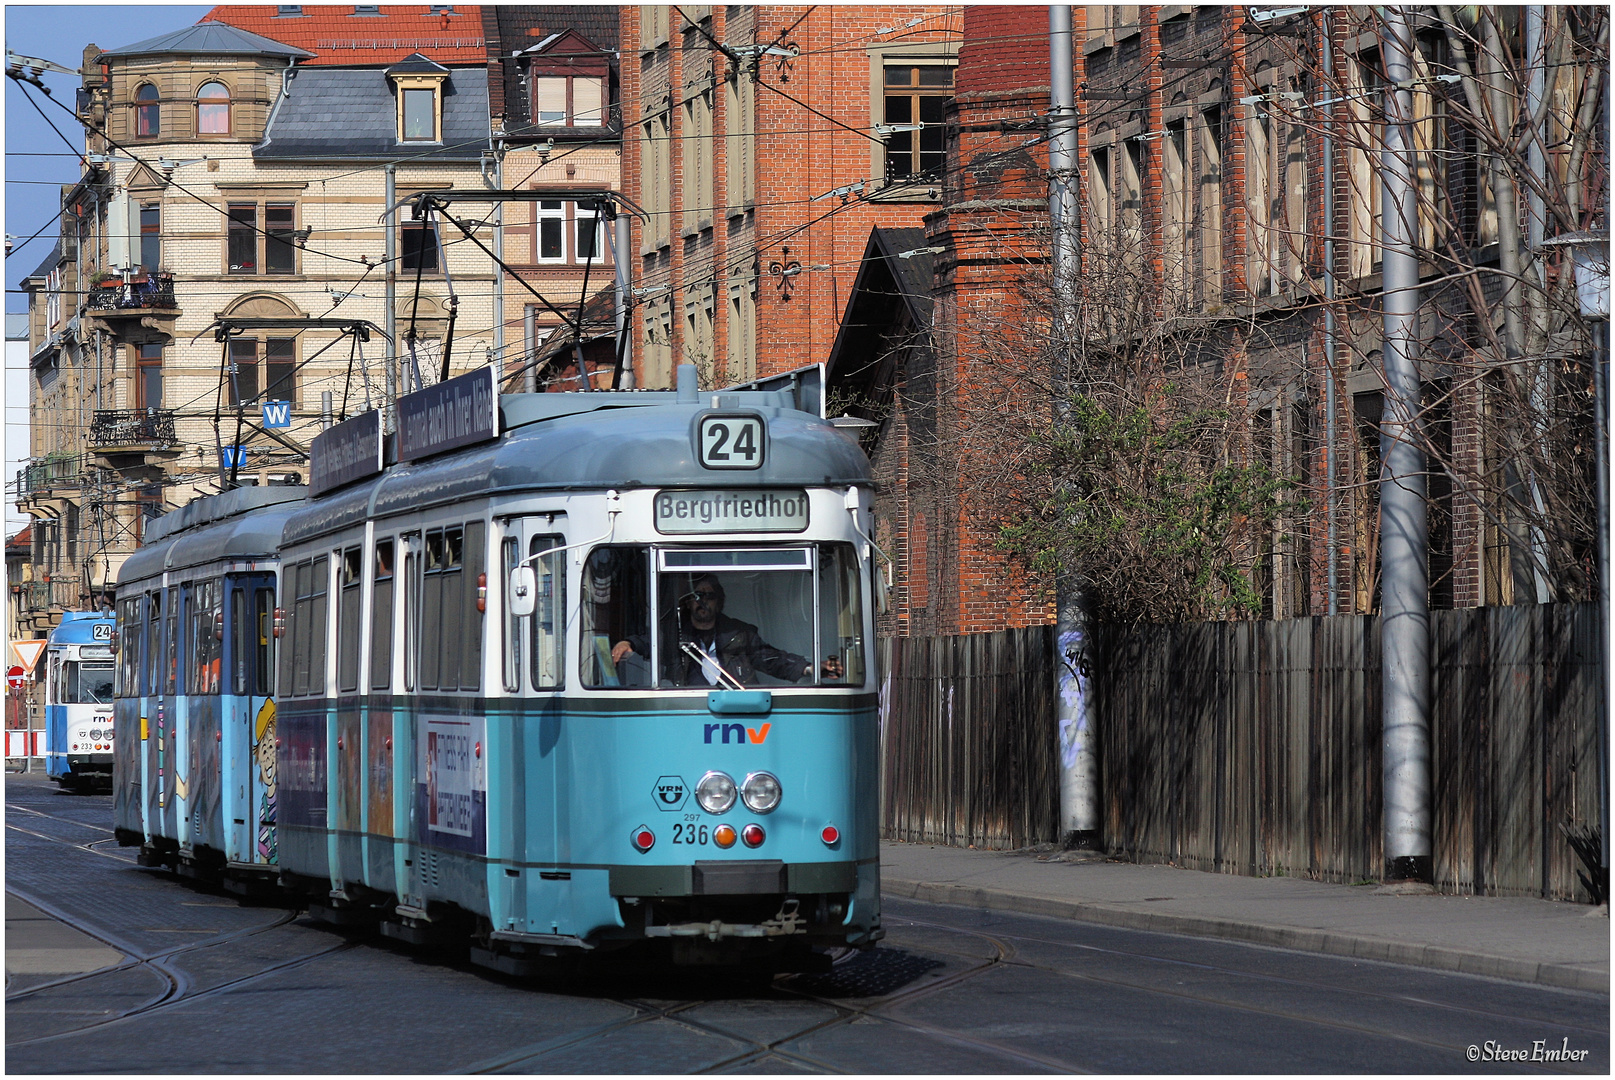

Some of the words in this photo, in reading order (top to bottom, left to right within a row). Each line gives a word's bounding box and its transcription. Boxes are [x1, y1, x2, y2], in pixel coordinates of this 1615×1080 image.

[264, 405, 288, 425] W
[428, 391, 446, 446] auch
[446, 389, 455, 440] in
[454, 386, 471, 437] Ihrer
[472, 377, 492, 433] Nähe
[707, 423, 756, 461] 24
[659, 494, 805, 524] Bergfriedhof
[95, 626, 110, 638] 24
[703, 723, 772, 744] rnv
[683, 813, 701, 822] 297
[672, 823, 709, 846] 236
